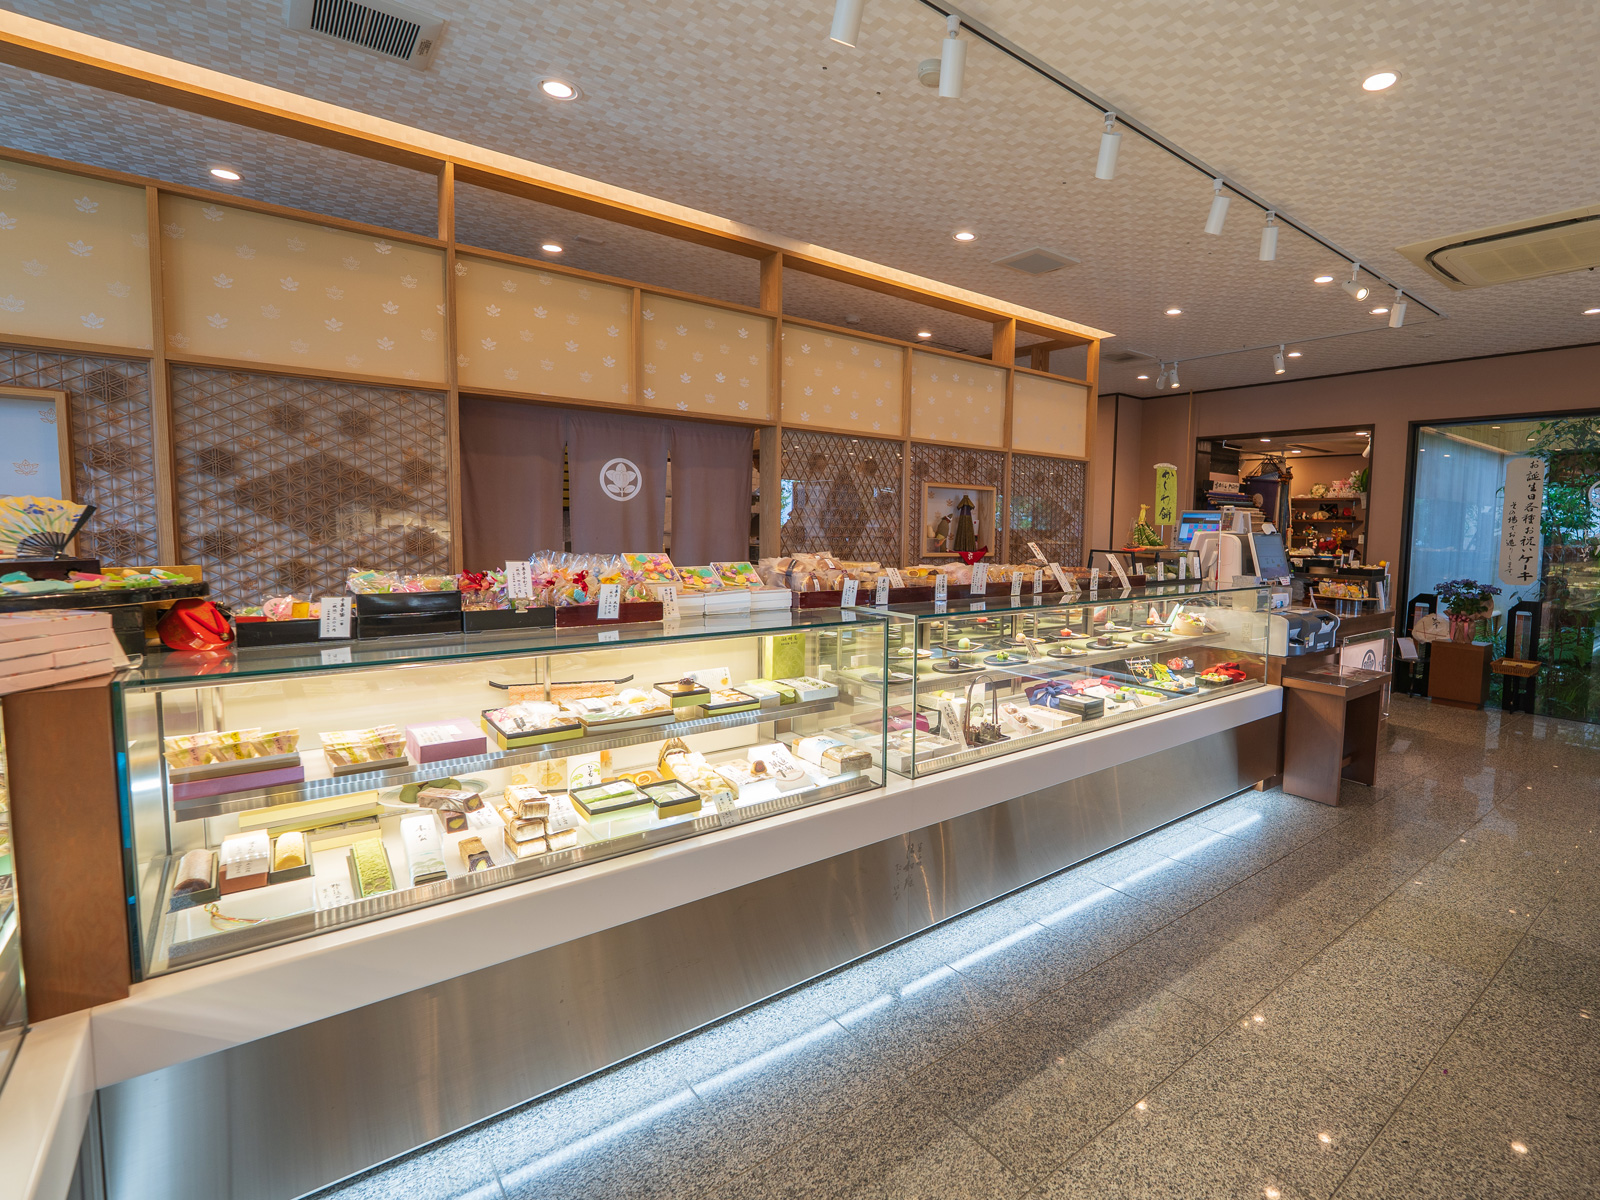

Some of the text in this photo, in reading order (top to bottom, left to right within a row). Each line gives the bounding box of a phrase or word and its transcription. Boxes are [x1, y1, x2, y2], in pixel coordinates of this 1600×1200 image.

[1158, 470, 1175, 523] かしわ餅
[1517, 460, 1542, 582] お誕生日各種お祝いケーキ
